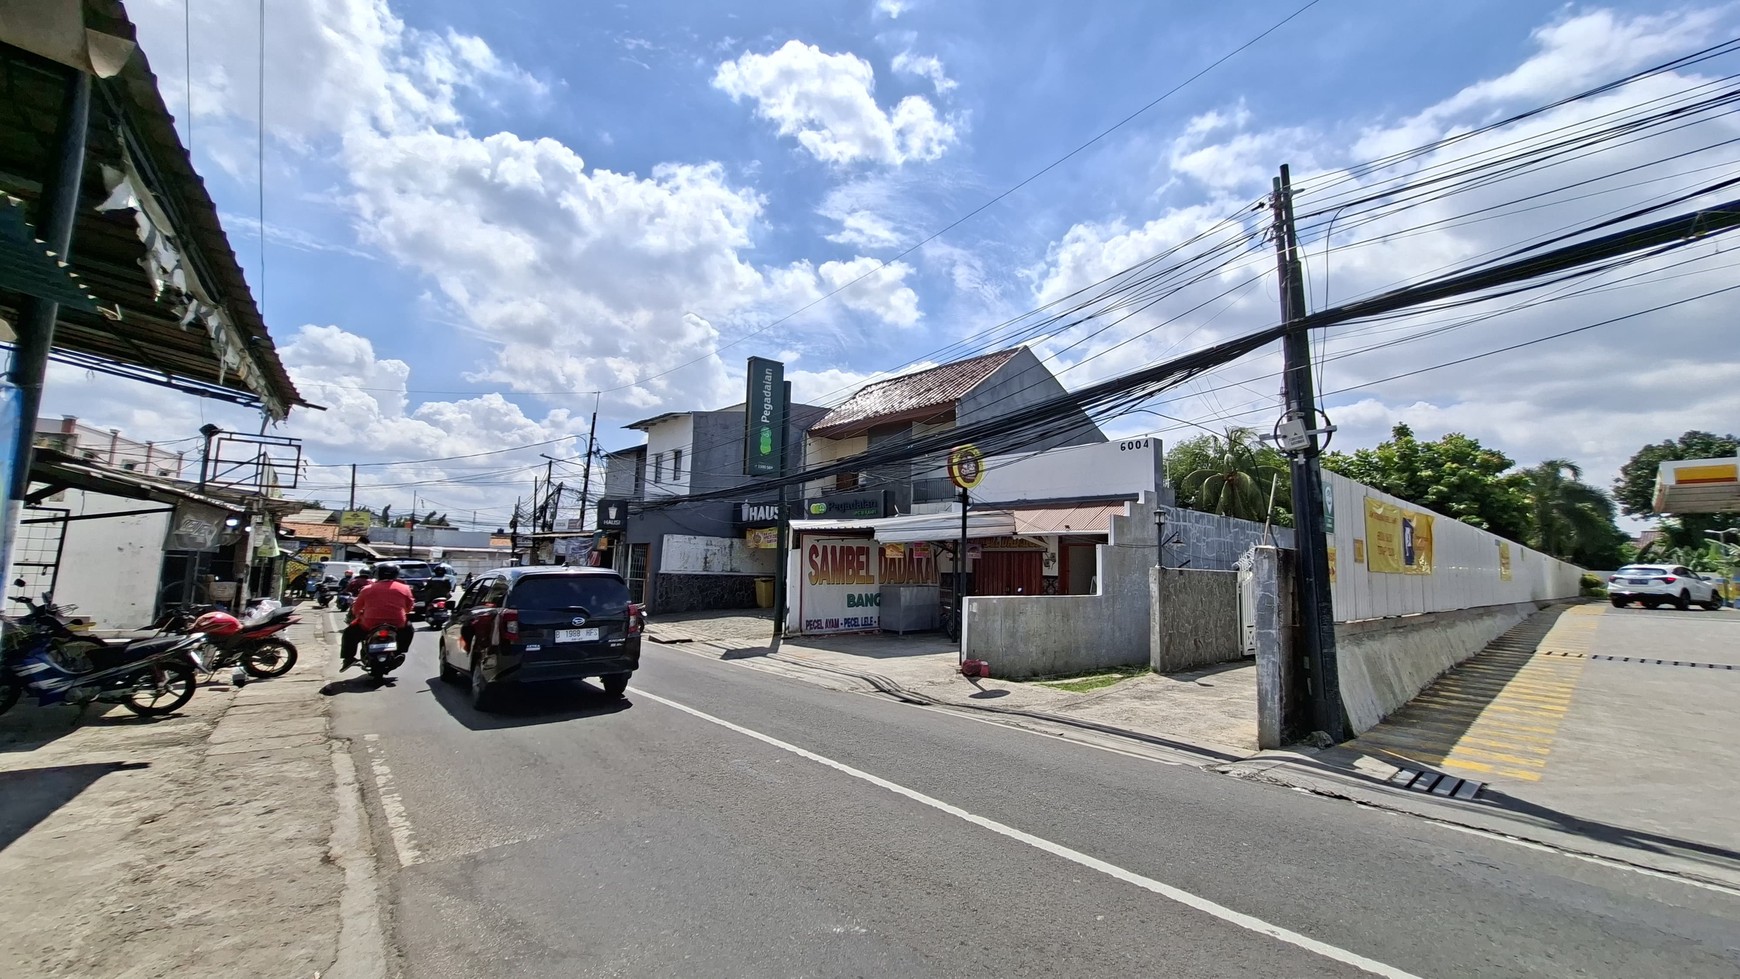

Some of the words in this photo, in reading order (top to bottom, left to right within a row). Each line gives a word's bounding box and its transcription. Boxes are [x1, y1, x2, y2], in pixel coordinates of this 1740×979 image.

[760, 368, 773, 423] Pegadaian
[1120, 439, 1149, 451] 6004
[828, 499, 878, 513] Pegadaian
[808, 544, 875, 585] SAMBEL
[805, 619, 824, 630] PECEL
[825, 618, 840, 629] AYAM
[843, 617, 860, 628] PECEL
[861, 616, 873, 627] LELE
